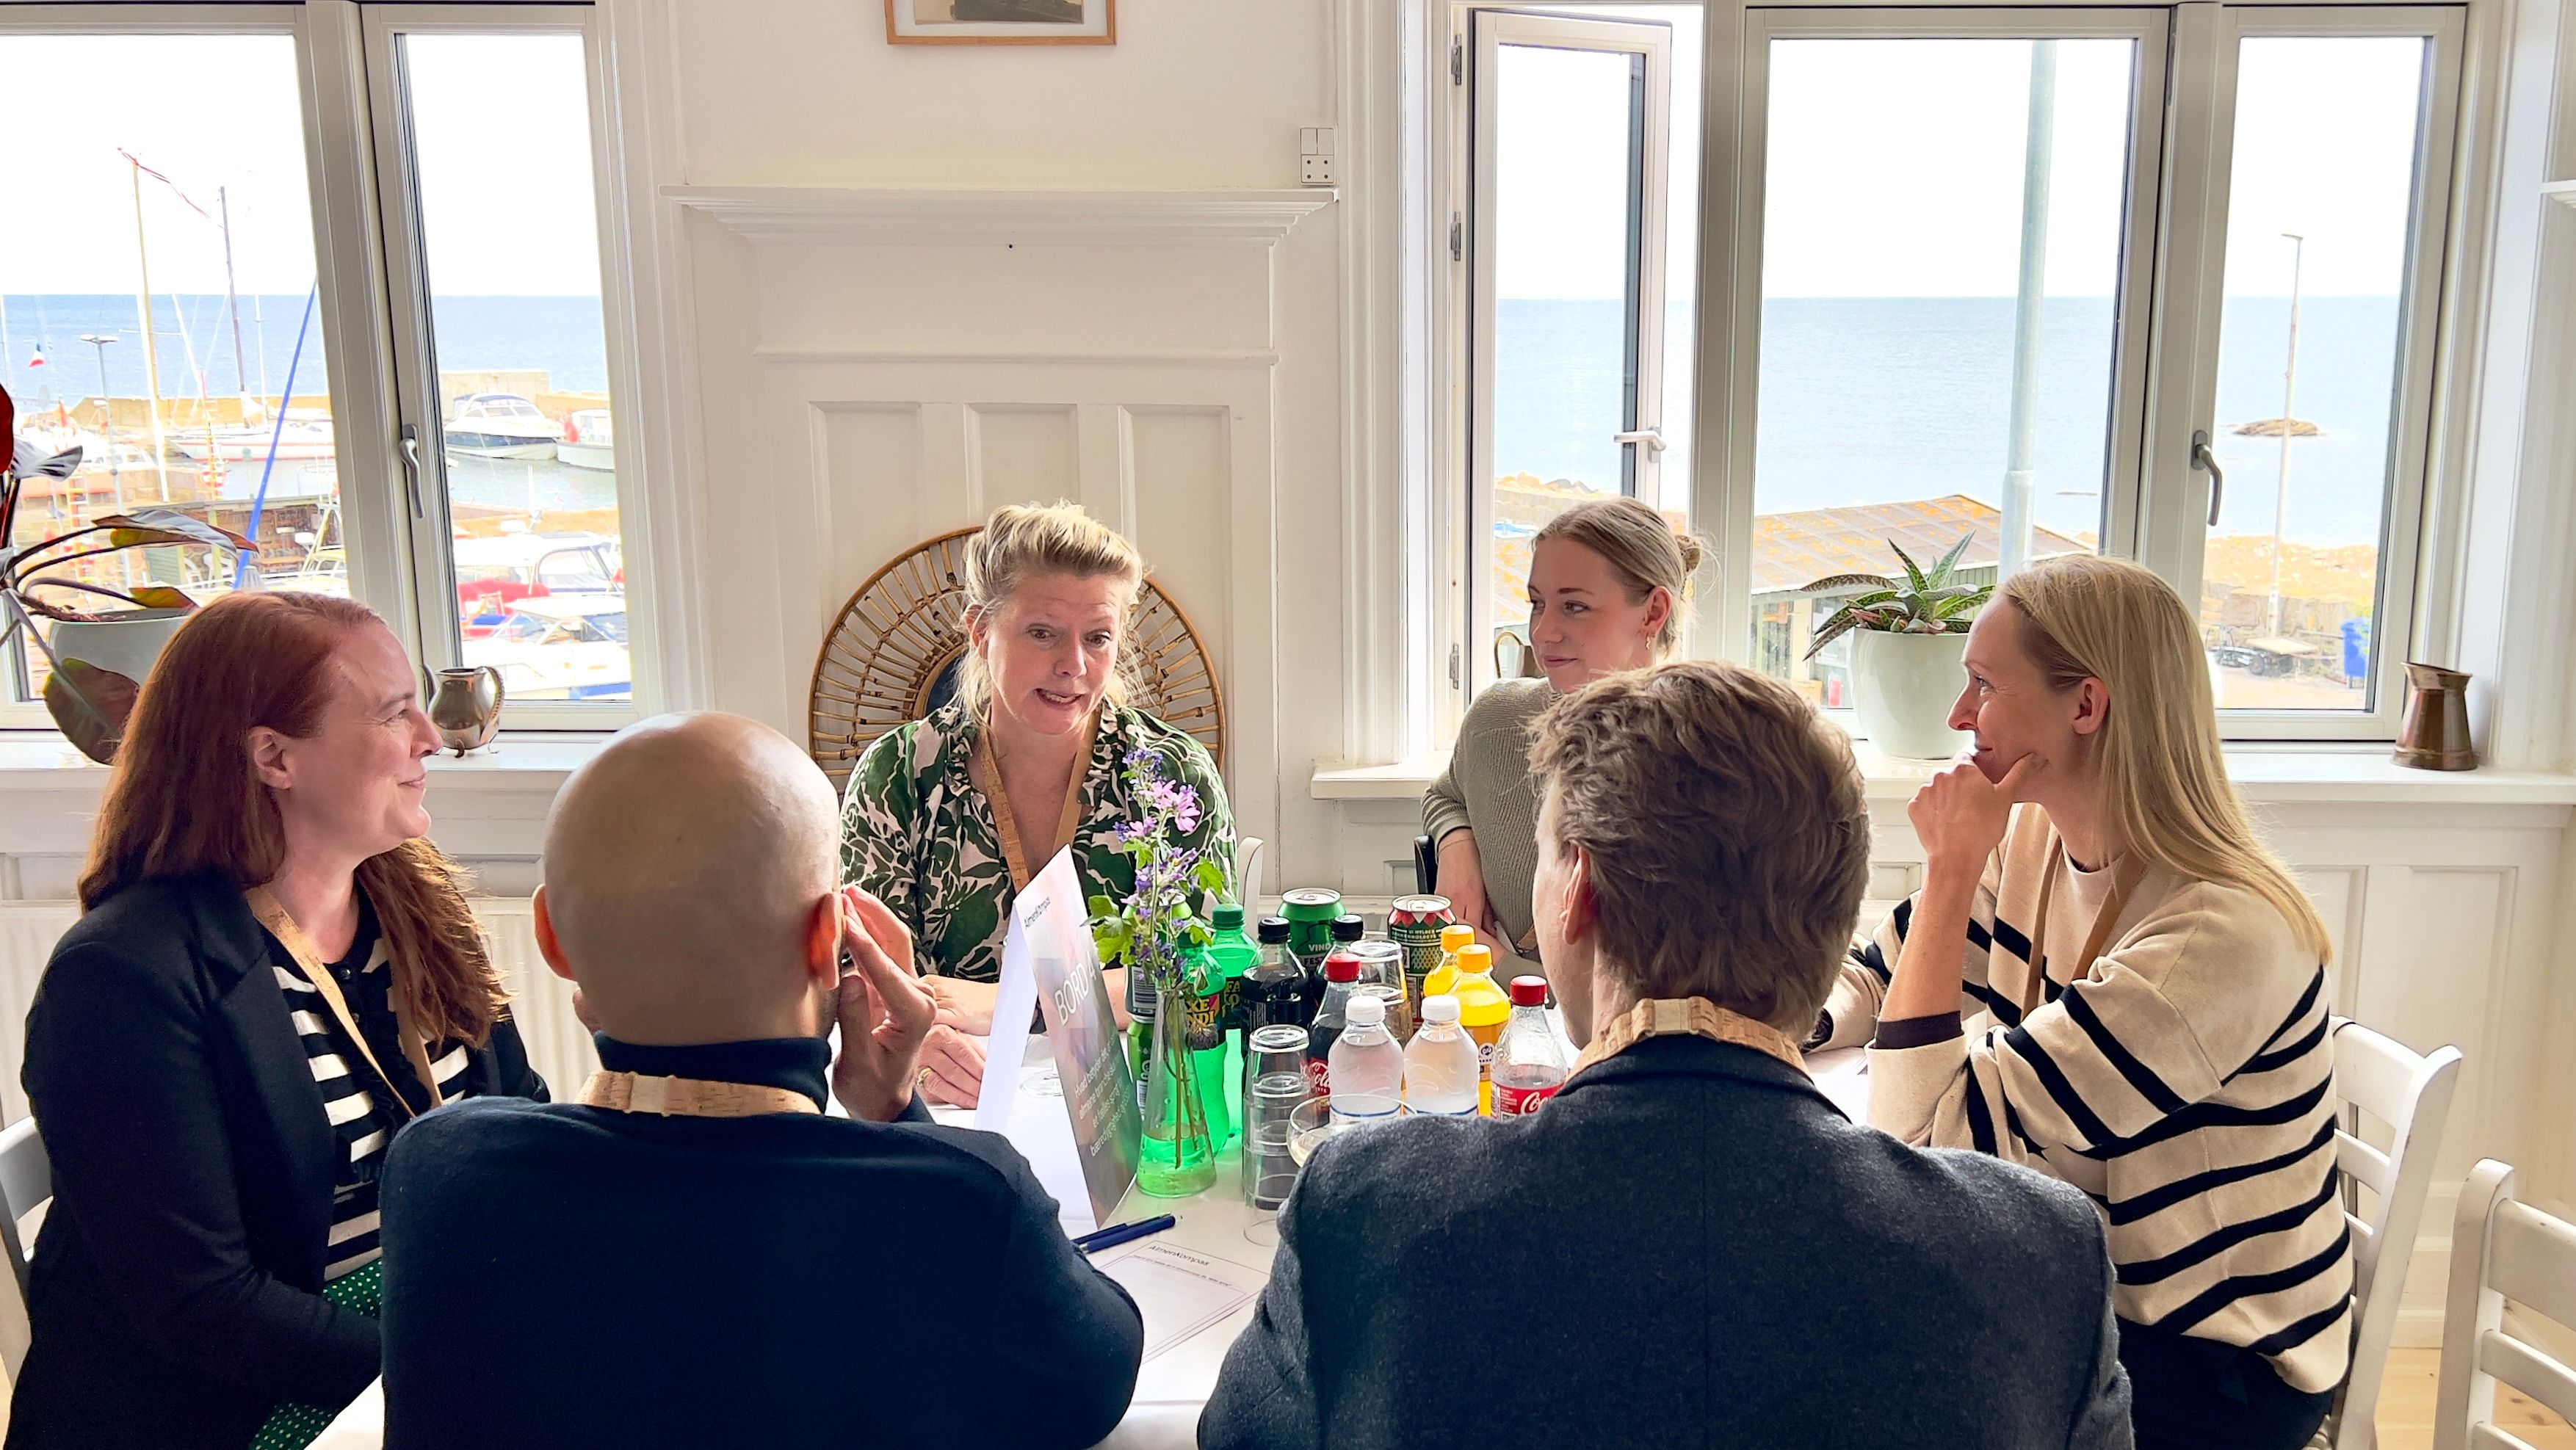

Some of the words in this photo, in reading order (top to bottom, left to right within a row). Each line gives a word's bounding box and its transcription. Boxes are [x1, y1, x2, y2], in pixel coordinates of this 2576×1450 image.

[1054, 963, 1089, 1025] BORD
[1087, 950, 1097, 982] 4
[1224, 980, 1241, 993] FA
[1185, 998, 1210, 1012] XE
[1186, 1010, 1215, 1027] NDI
[1074, 1074, 1088, 1098] Hvad
[1148, 1244, 1210, 1266] AlmenKompas
